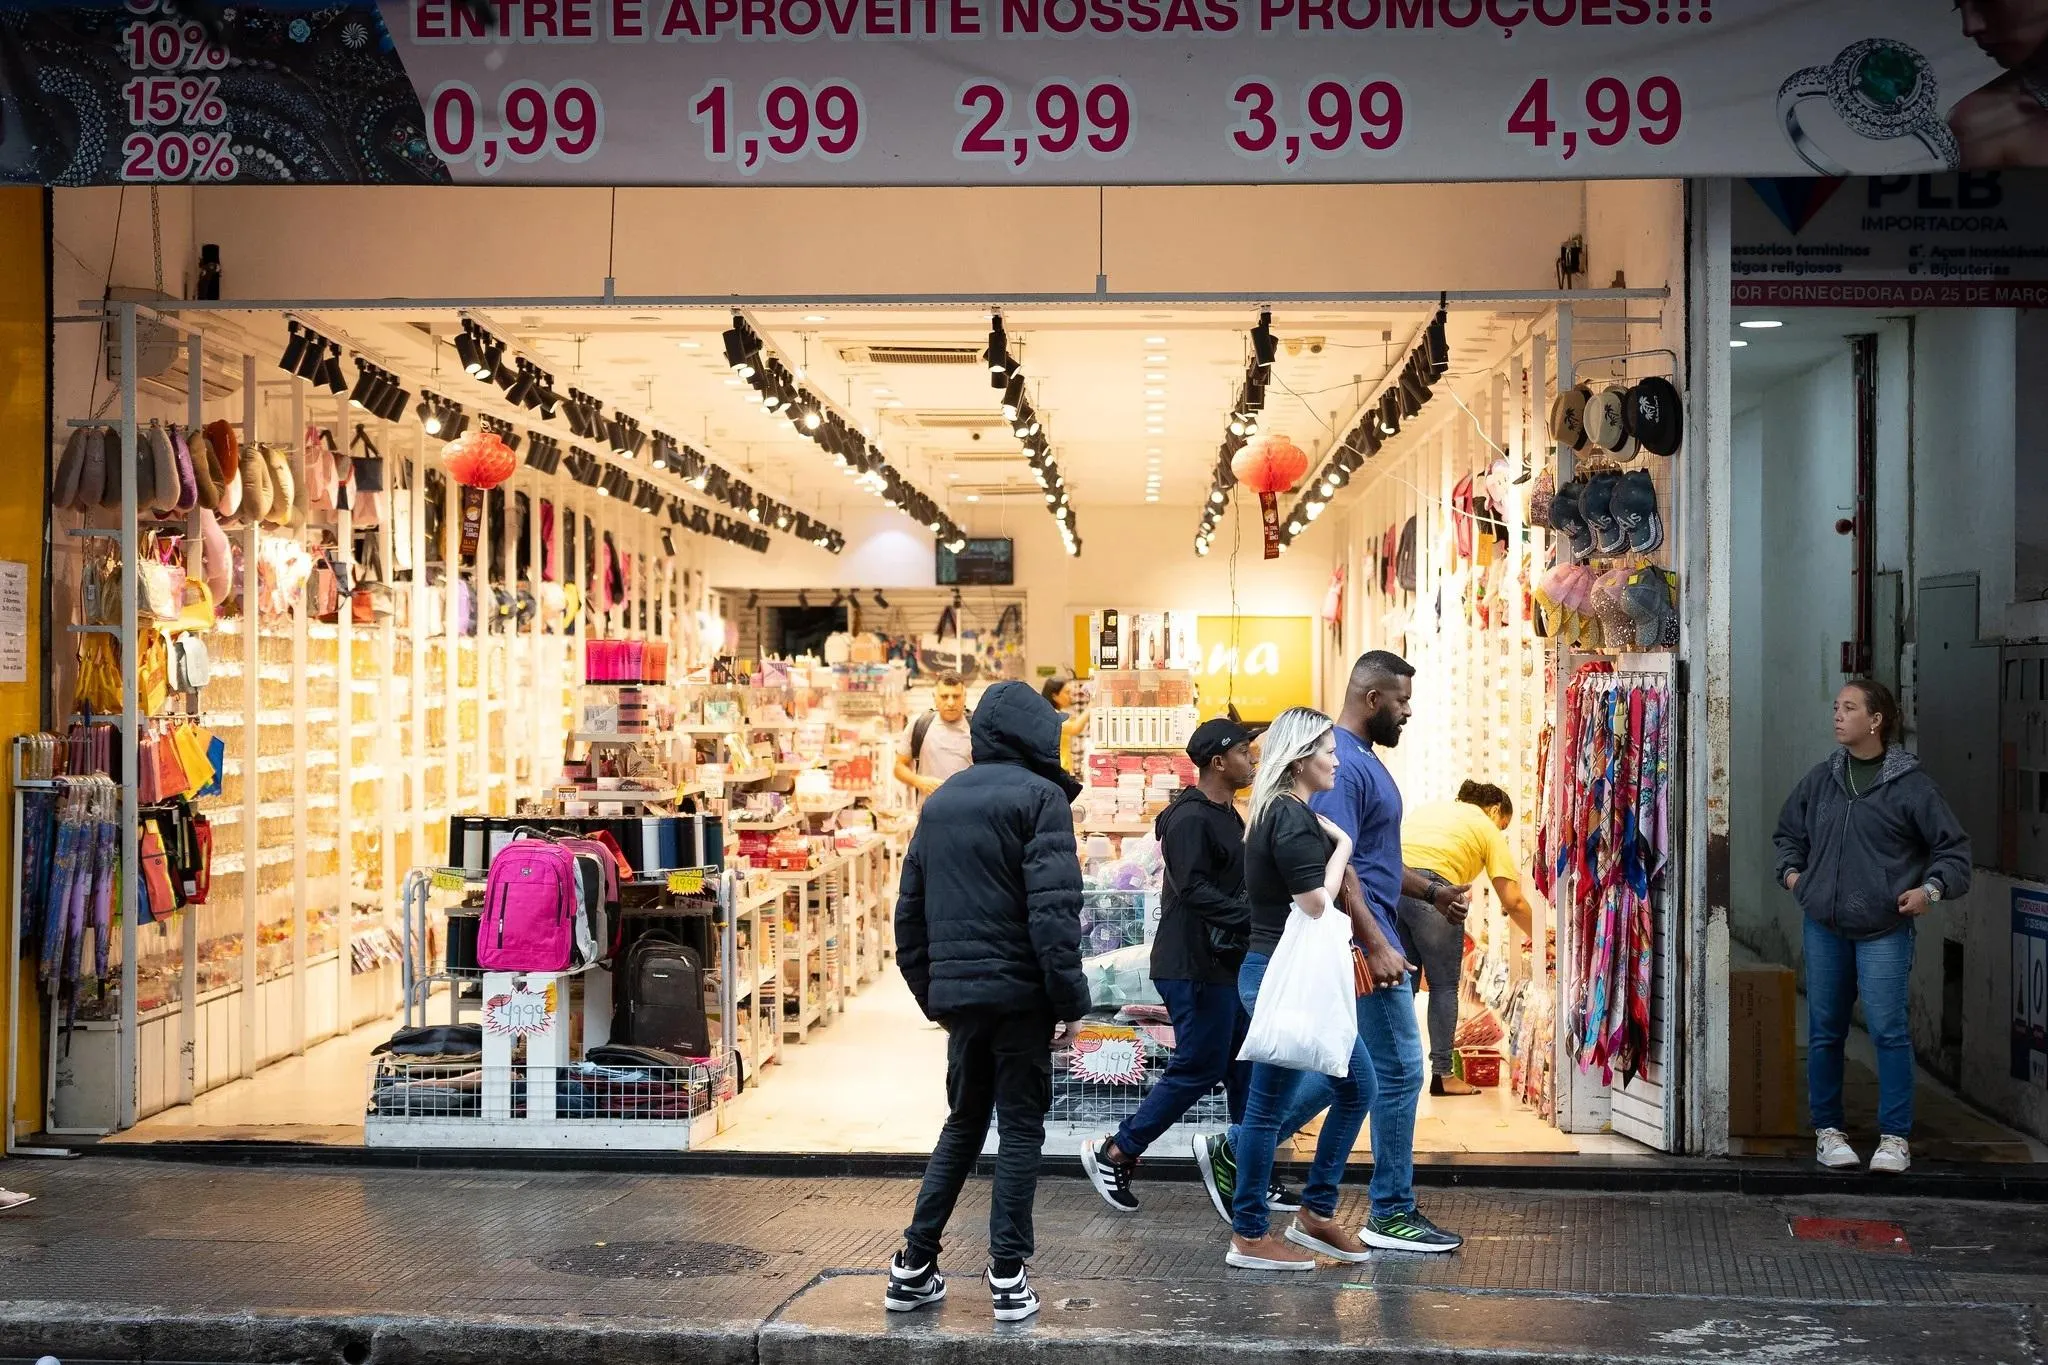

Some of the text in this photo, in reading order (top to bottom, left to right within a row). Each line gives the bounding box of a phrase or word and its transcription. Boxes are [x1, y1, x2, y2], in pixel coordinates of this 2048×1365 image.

[416, 0, 592, 38] ENTRE
[613, 0, 643, 37] E
[661, 0, 981, 37] APROVEITE
[1001, 0, 1240, 34] NOSSAS
[127, 25, 226, 66] 10%
[126, 80, 224, 122] 15%
[432, 76, 1683, 168] 0,99 1,99 2,99 3,99 4,99
[125, 135, 236, 178] 20%
[1868, 171, 2003, 209] PLB
[1862, 216, 2008, 232] IMPORTADORA
[1771, 260, 1843, 276] religiosos
[1767, 286, 1904, 301] FORNECEDORA
[1911, 287, 1936, 301] DA
[1941, 287, 1961, 301] 25
[1966, 287, 1991, 301] DE
